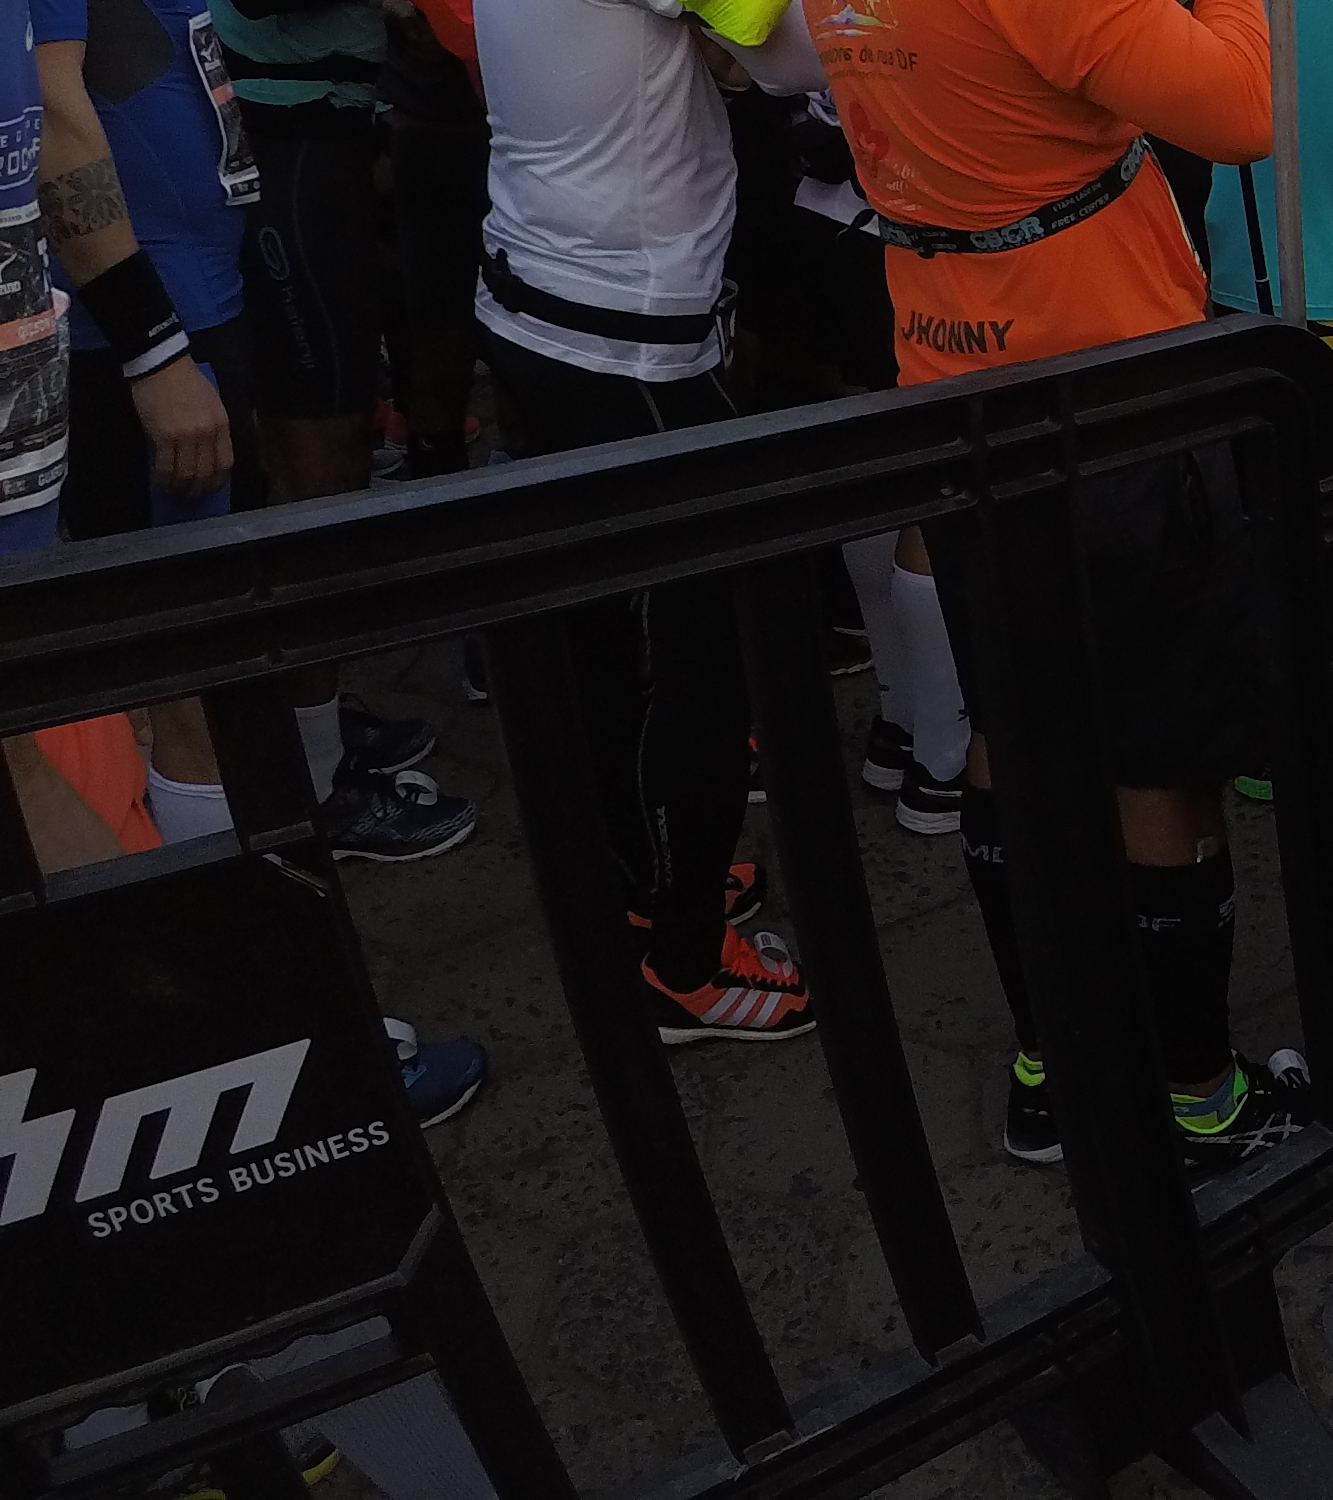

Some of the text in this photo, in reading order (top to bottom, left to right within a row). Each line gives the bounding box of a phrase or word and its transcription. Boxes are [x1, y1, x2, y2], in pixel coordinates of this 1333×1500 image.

[901, 310, 1015, 354] JHONNY
[88, 1120, 390, 1238] SPORTS BUSINESS
